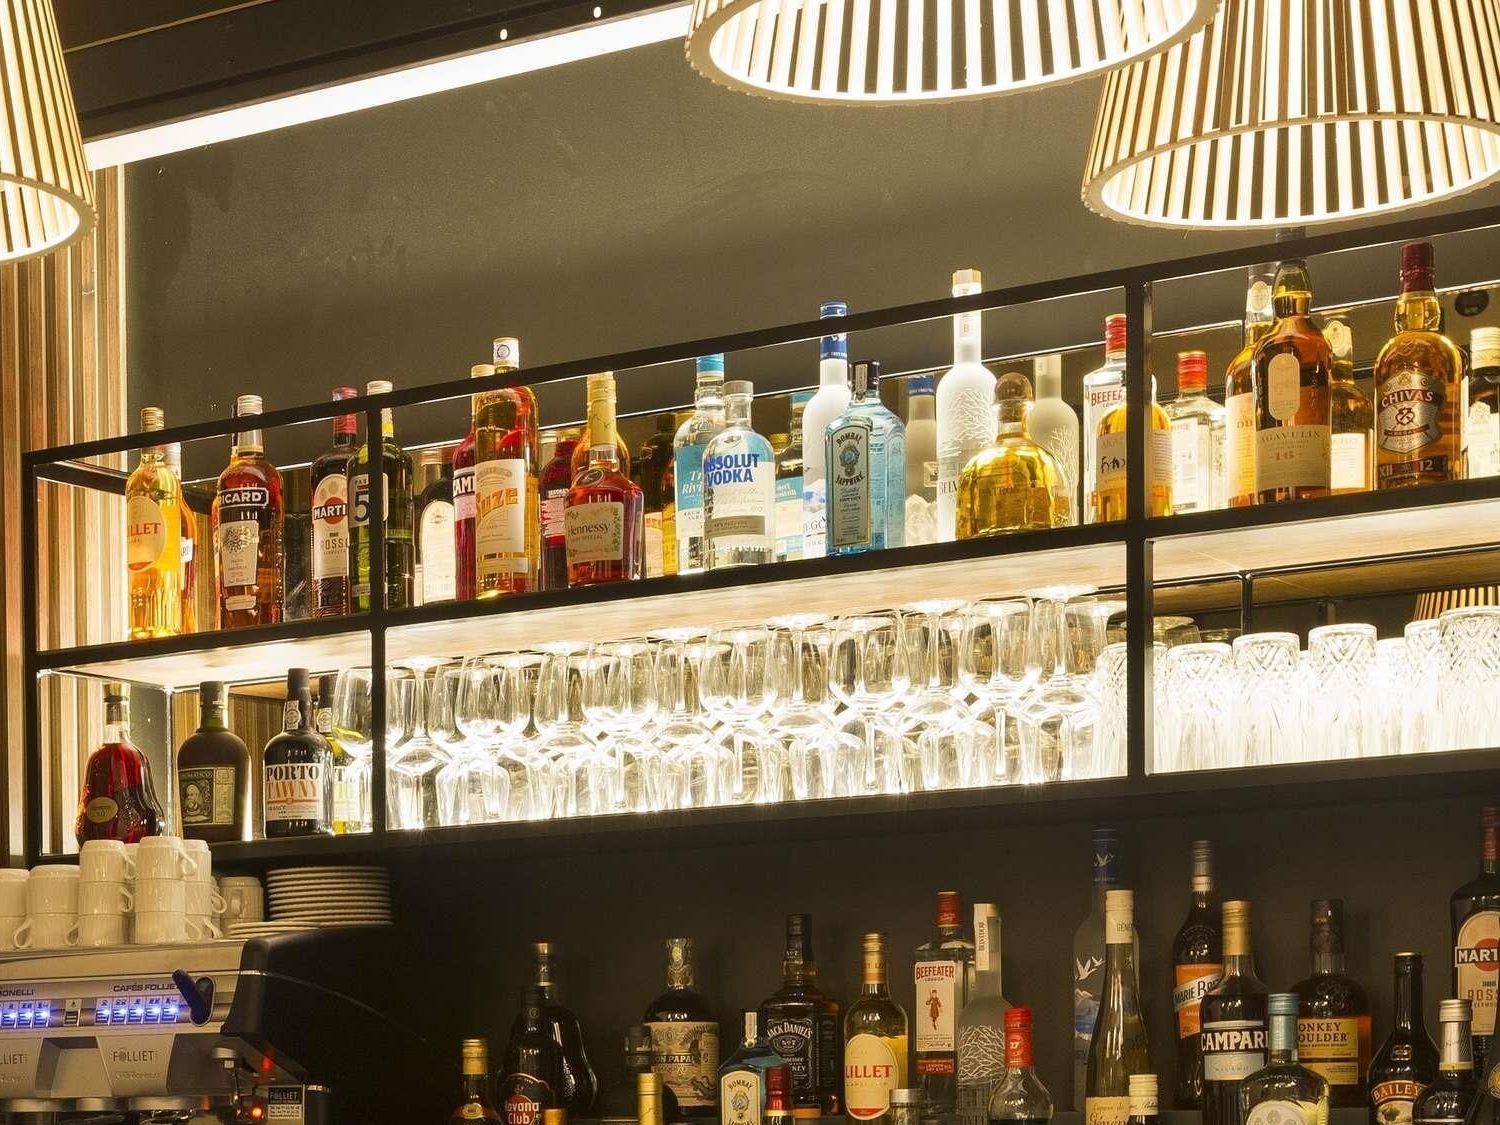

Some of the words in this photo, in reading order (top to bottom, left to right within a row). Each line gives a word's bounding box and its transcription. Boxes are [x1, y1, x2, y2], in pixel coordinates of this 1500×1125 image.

[1381, 391, 1433, 408] CHIVAS
[703, 453, 760, 473] ABSOLUT
[1419, 459, 1434, 472] 12
[707, 468, 754, 487] VODKA
[313, 503, 347, 521] MARTI
[569, 522, 610, 536] Hennessy
[266, 766, 320, 783] PORTO
[1457, 947, 1499, 963] MART
[915, 965, 955, 981] BEEFEATER
[113, 983, 143, 992] CAFÉS
[143, 982, 179, 991] FOLLIE
[1175, 982, 1196, 1003] MARIE
[767, 1024, 783, 1040] JACK
[783, 1021, 813, 1039] DANIEL'S
[113, 1050, 156, 1062] FOLLIET
[668, 1055, 693, 1063] PAPA
[728, 1079, 753, 1091] BOMBAY
[507, 1112, 531, 1125] Club
